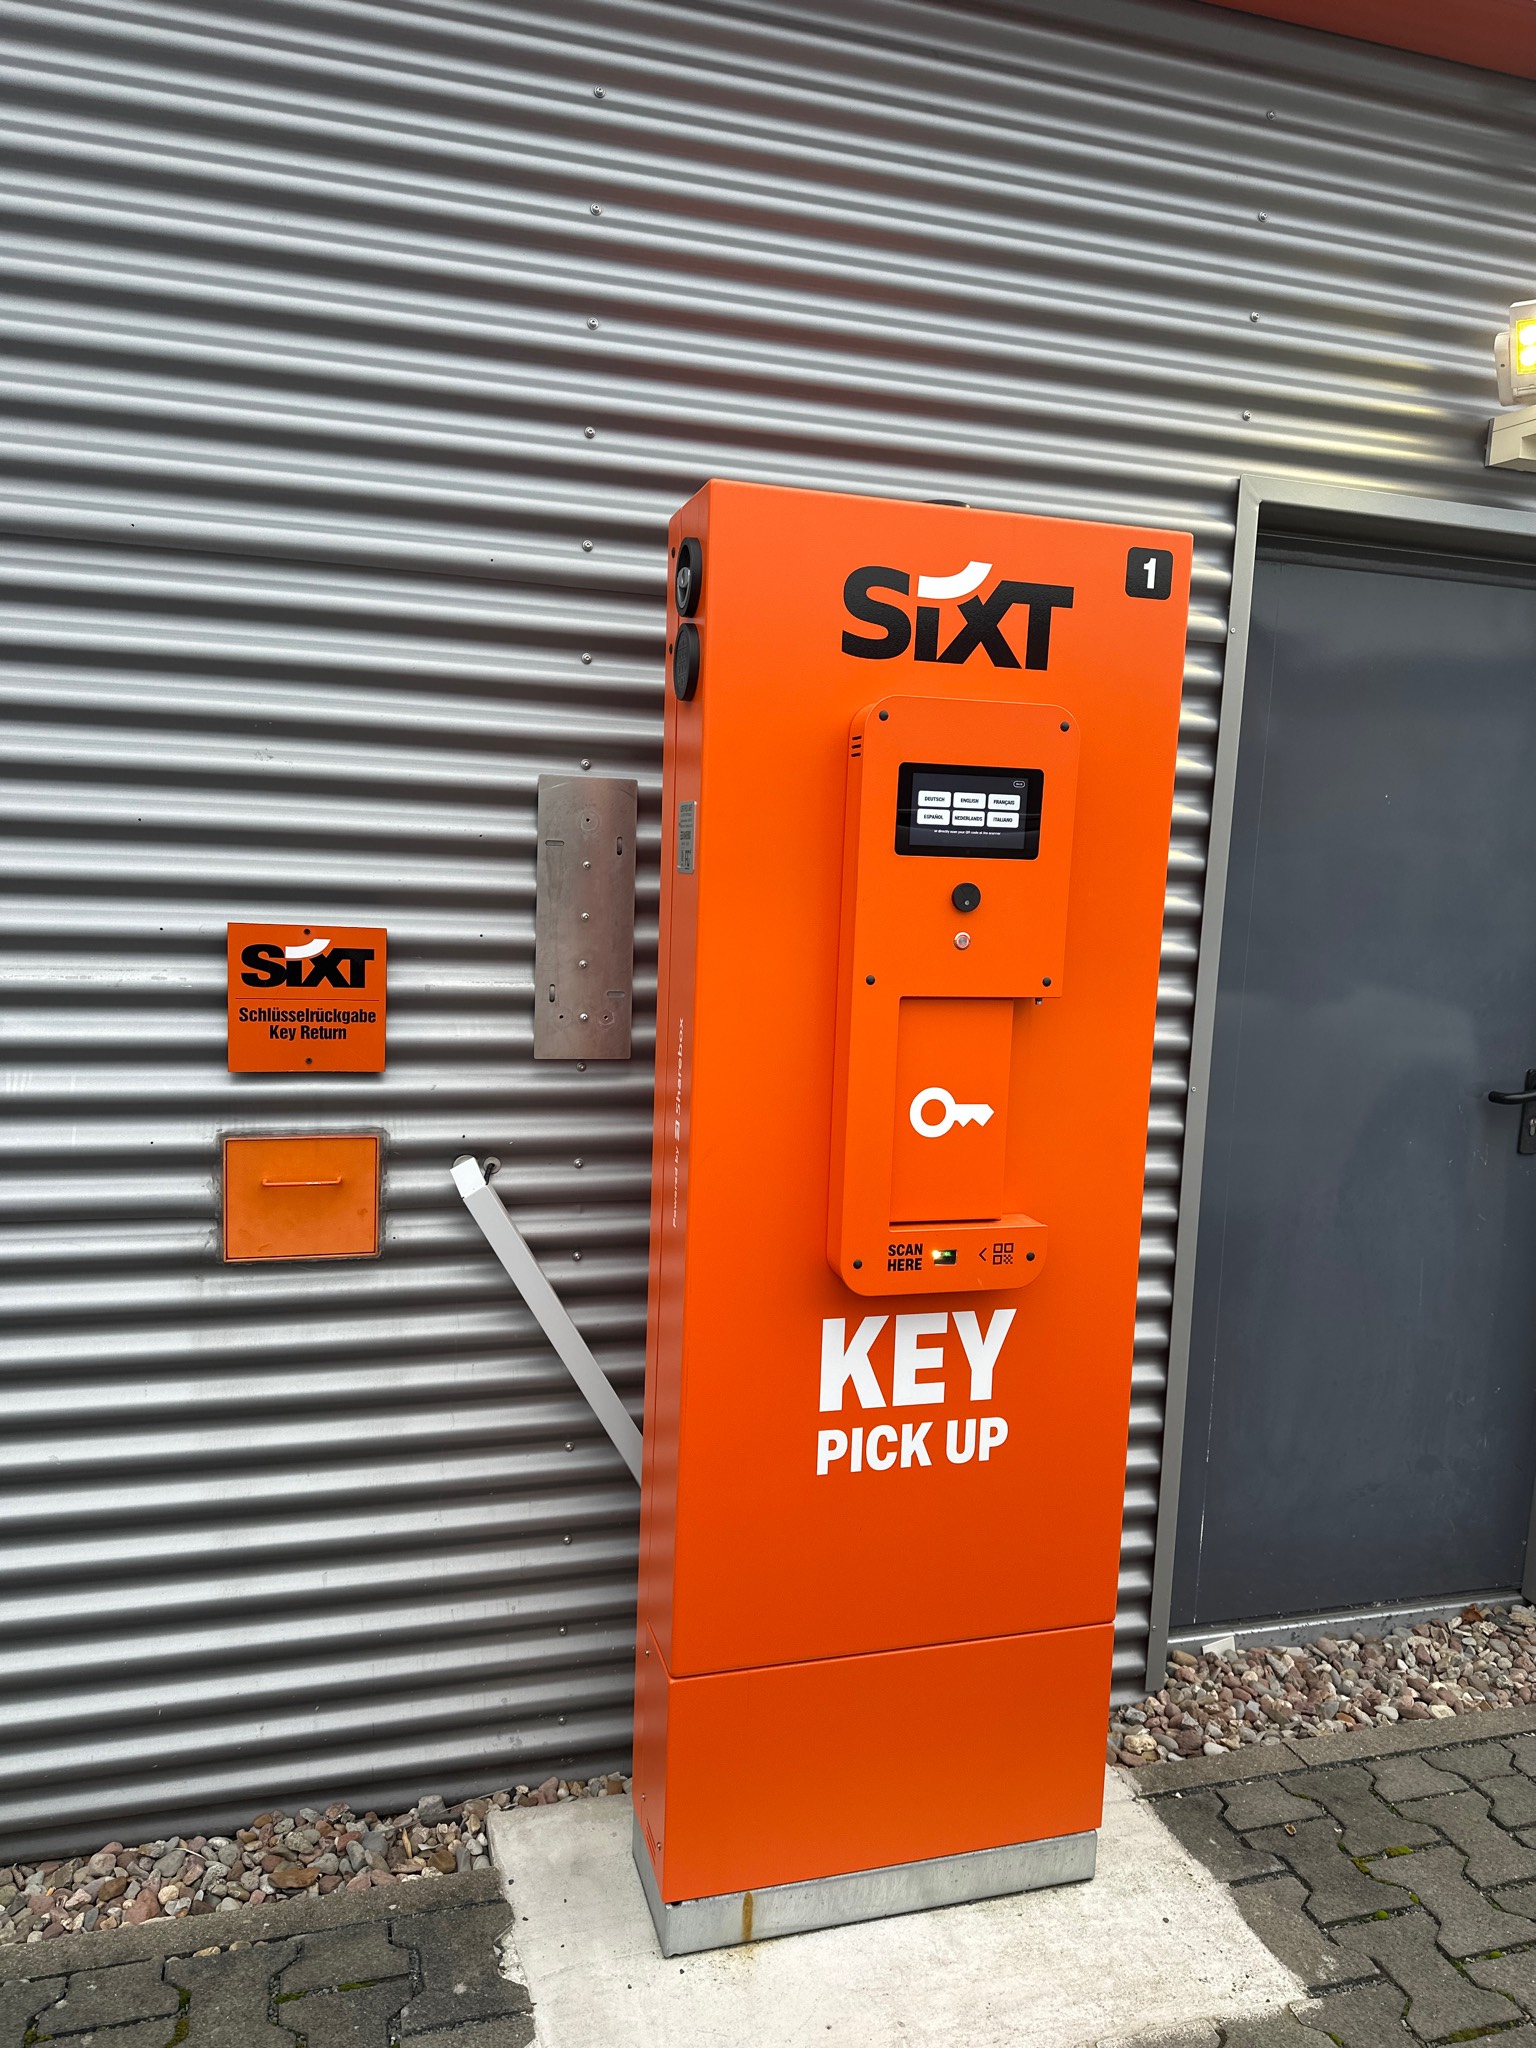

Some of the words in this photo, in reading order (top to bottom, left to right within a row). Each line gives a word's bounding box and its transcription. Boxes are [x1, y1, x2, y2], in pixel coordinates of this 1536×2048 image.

[1142, 558, 1157, 589] 1
[239, 1007, 377, 1024] Schlüsselrückgabe
[269, 1025, 296, 1041] Key
[301, 1025, 347, 1040] Return
[675, 1016, 685, 1115] Sharebox
[887, 1243, 923, 1256] SCAN
[887, 1258, 923, 1271] HERE
[819, 1308, 1018, 1412] KEY
[816, 1421, 934, 1476] PICK
[945, 1416, 1009, 1464] UP
